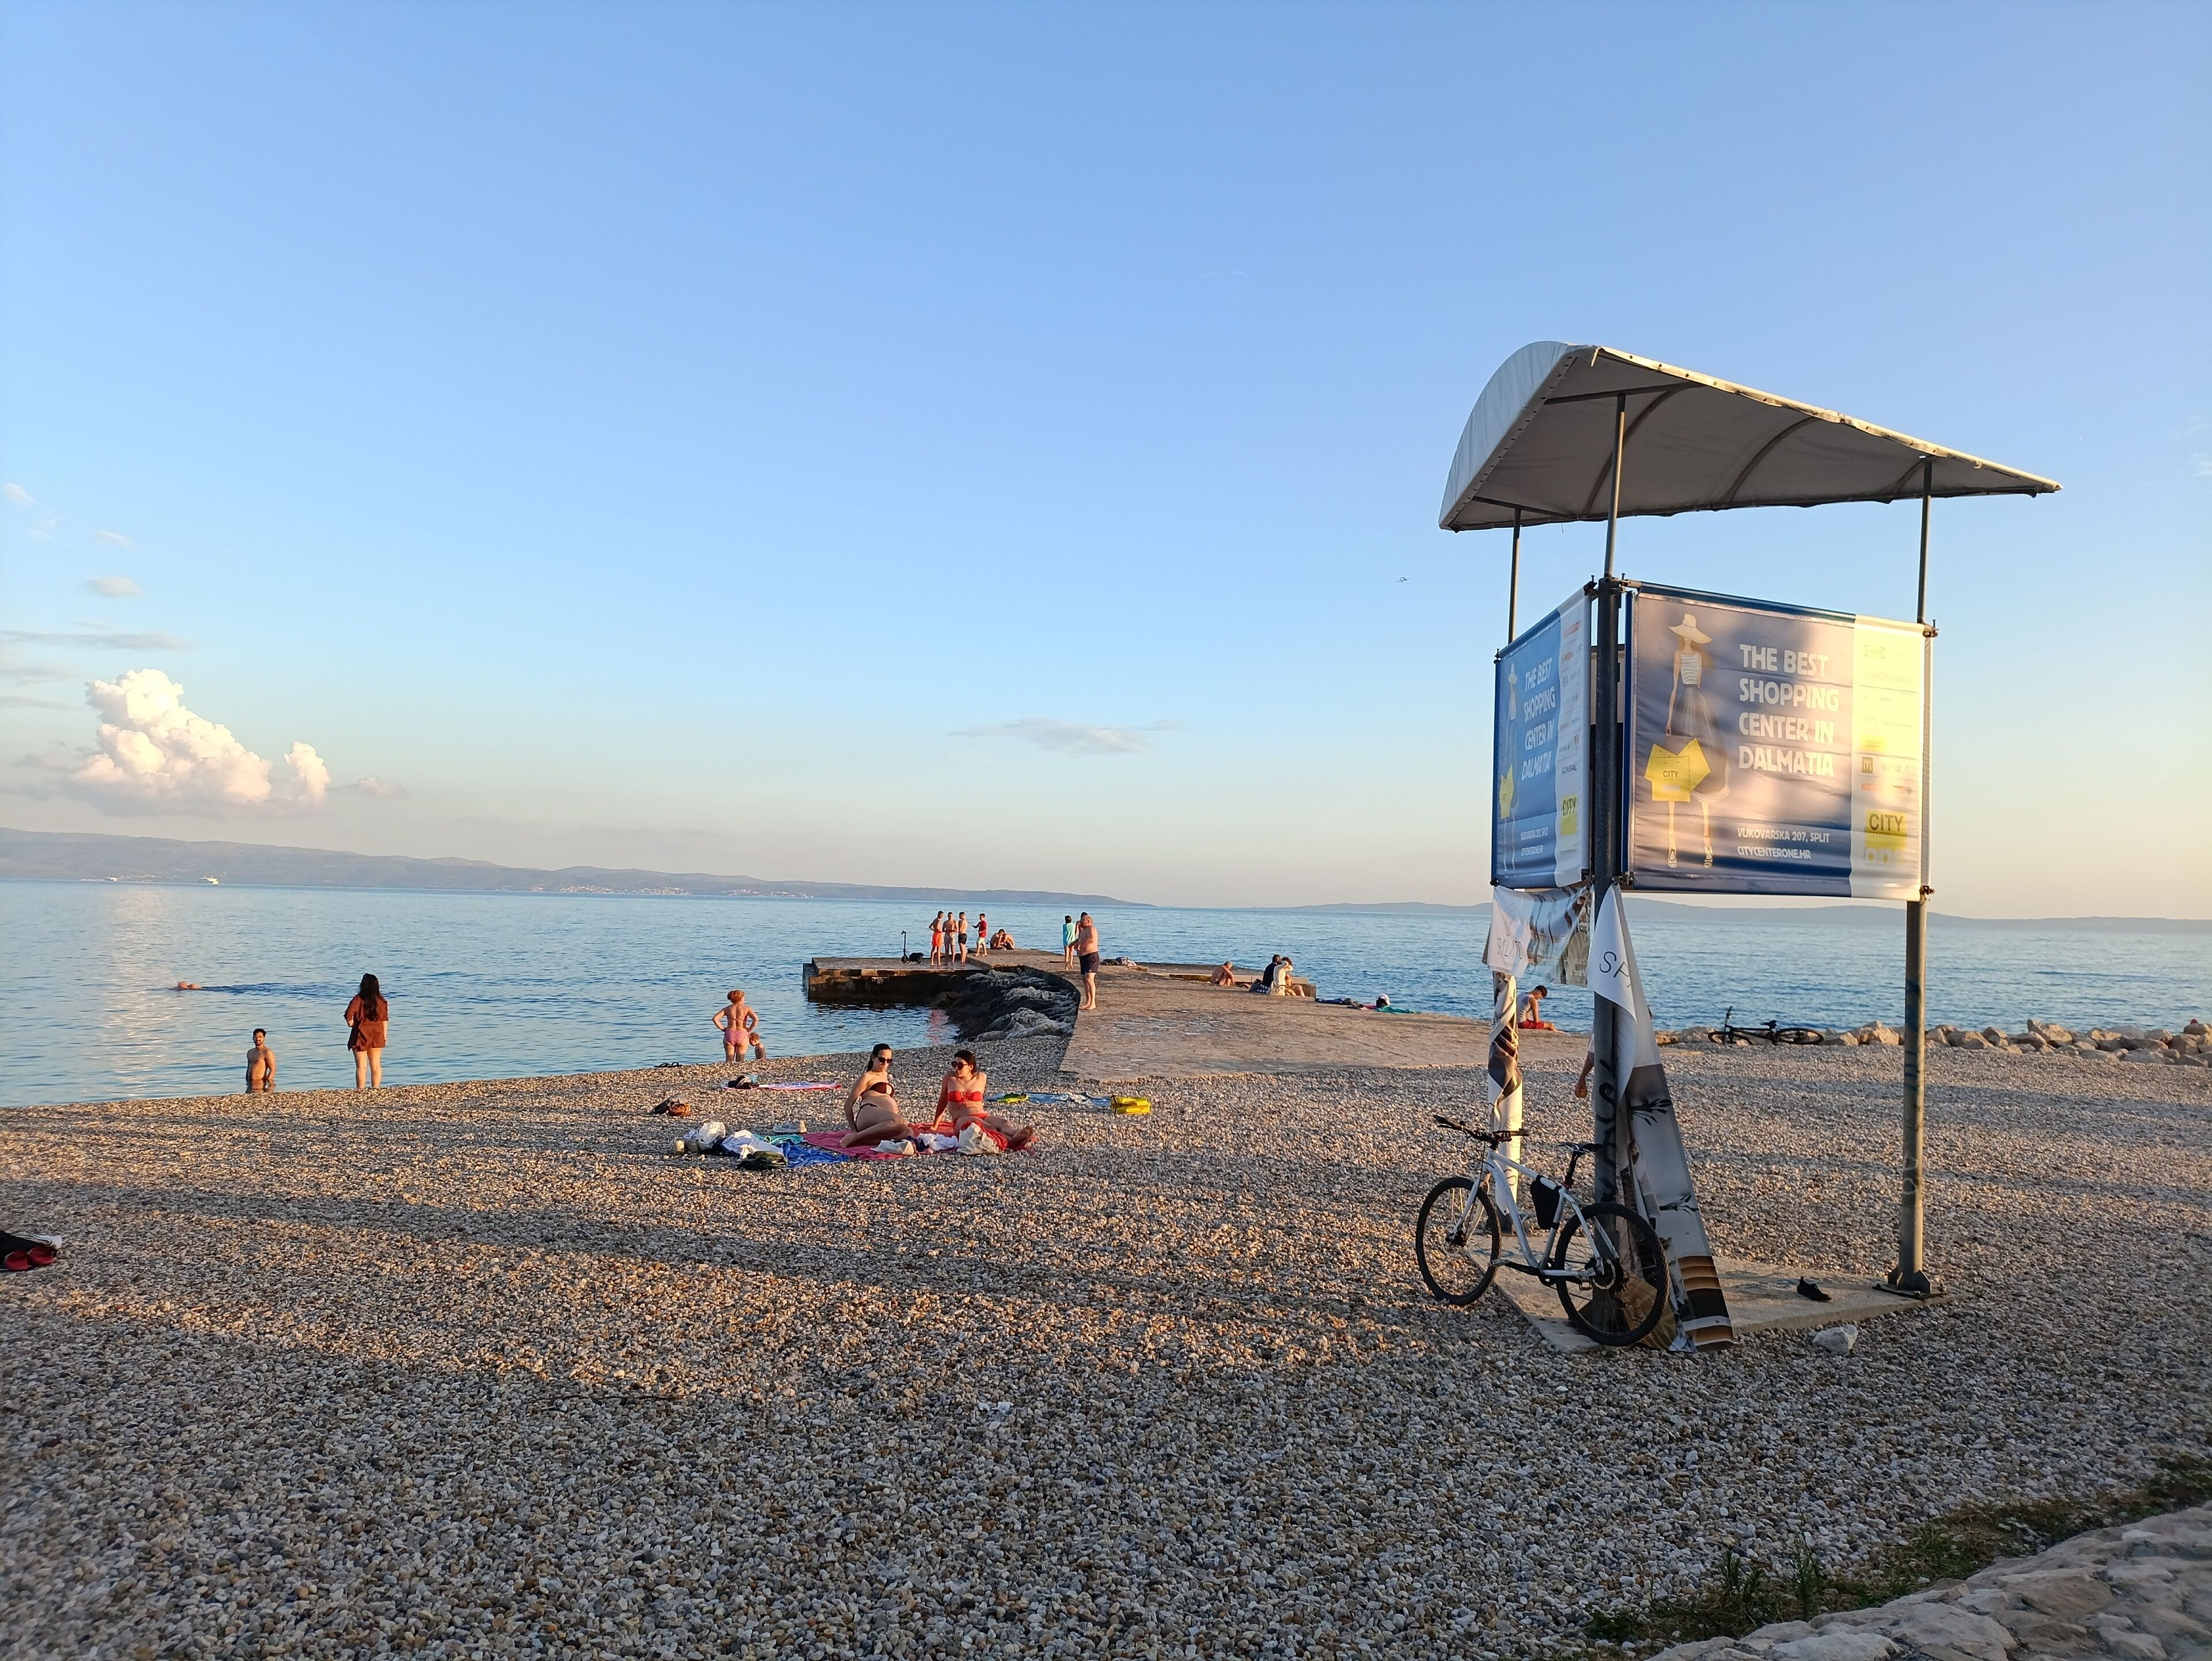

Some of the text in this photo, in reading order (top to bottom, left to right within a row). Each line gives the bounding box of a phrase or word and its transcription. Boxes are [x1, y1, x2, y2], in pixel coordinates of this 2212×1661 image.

[1525, 667, 1537, 692] THE
[1537, 657, 1552, 686] BEST
[1740, 644, 1829, 678] THE BEST
[1524, 686, 1555, 722] SHOPPING
[1739, 678, 1839, 712] SHOPPING
[1525, 723, 1546, 751] CENTER
[1547, 718, 1554, 742] IN
[1738, 712, 1835, 744] CENTER IN
[1521, 750, 1551, 781] DALMATIA
[1738, 746, 1835, 777] DALMATIA
[1562, 797, 1577, 817] CITY
[1869, 813, 1903, 831] CITY
[1737, 827, 1830, 843] VUKOVARSKA 207, SPLIT
[1737, 846, 1811, 860] CITYCENTERONE.HR
[1599, 951, 1631, 988] SP
